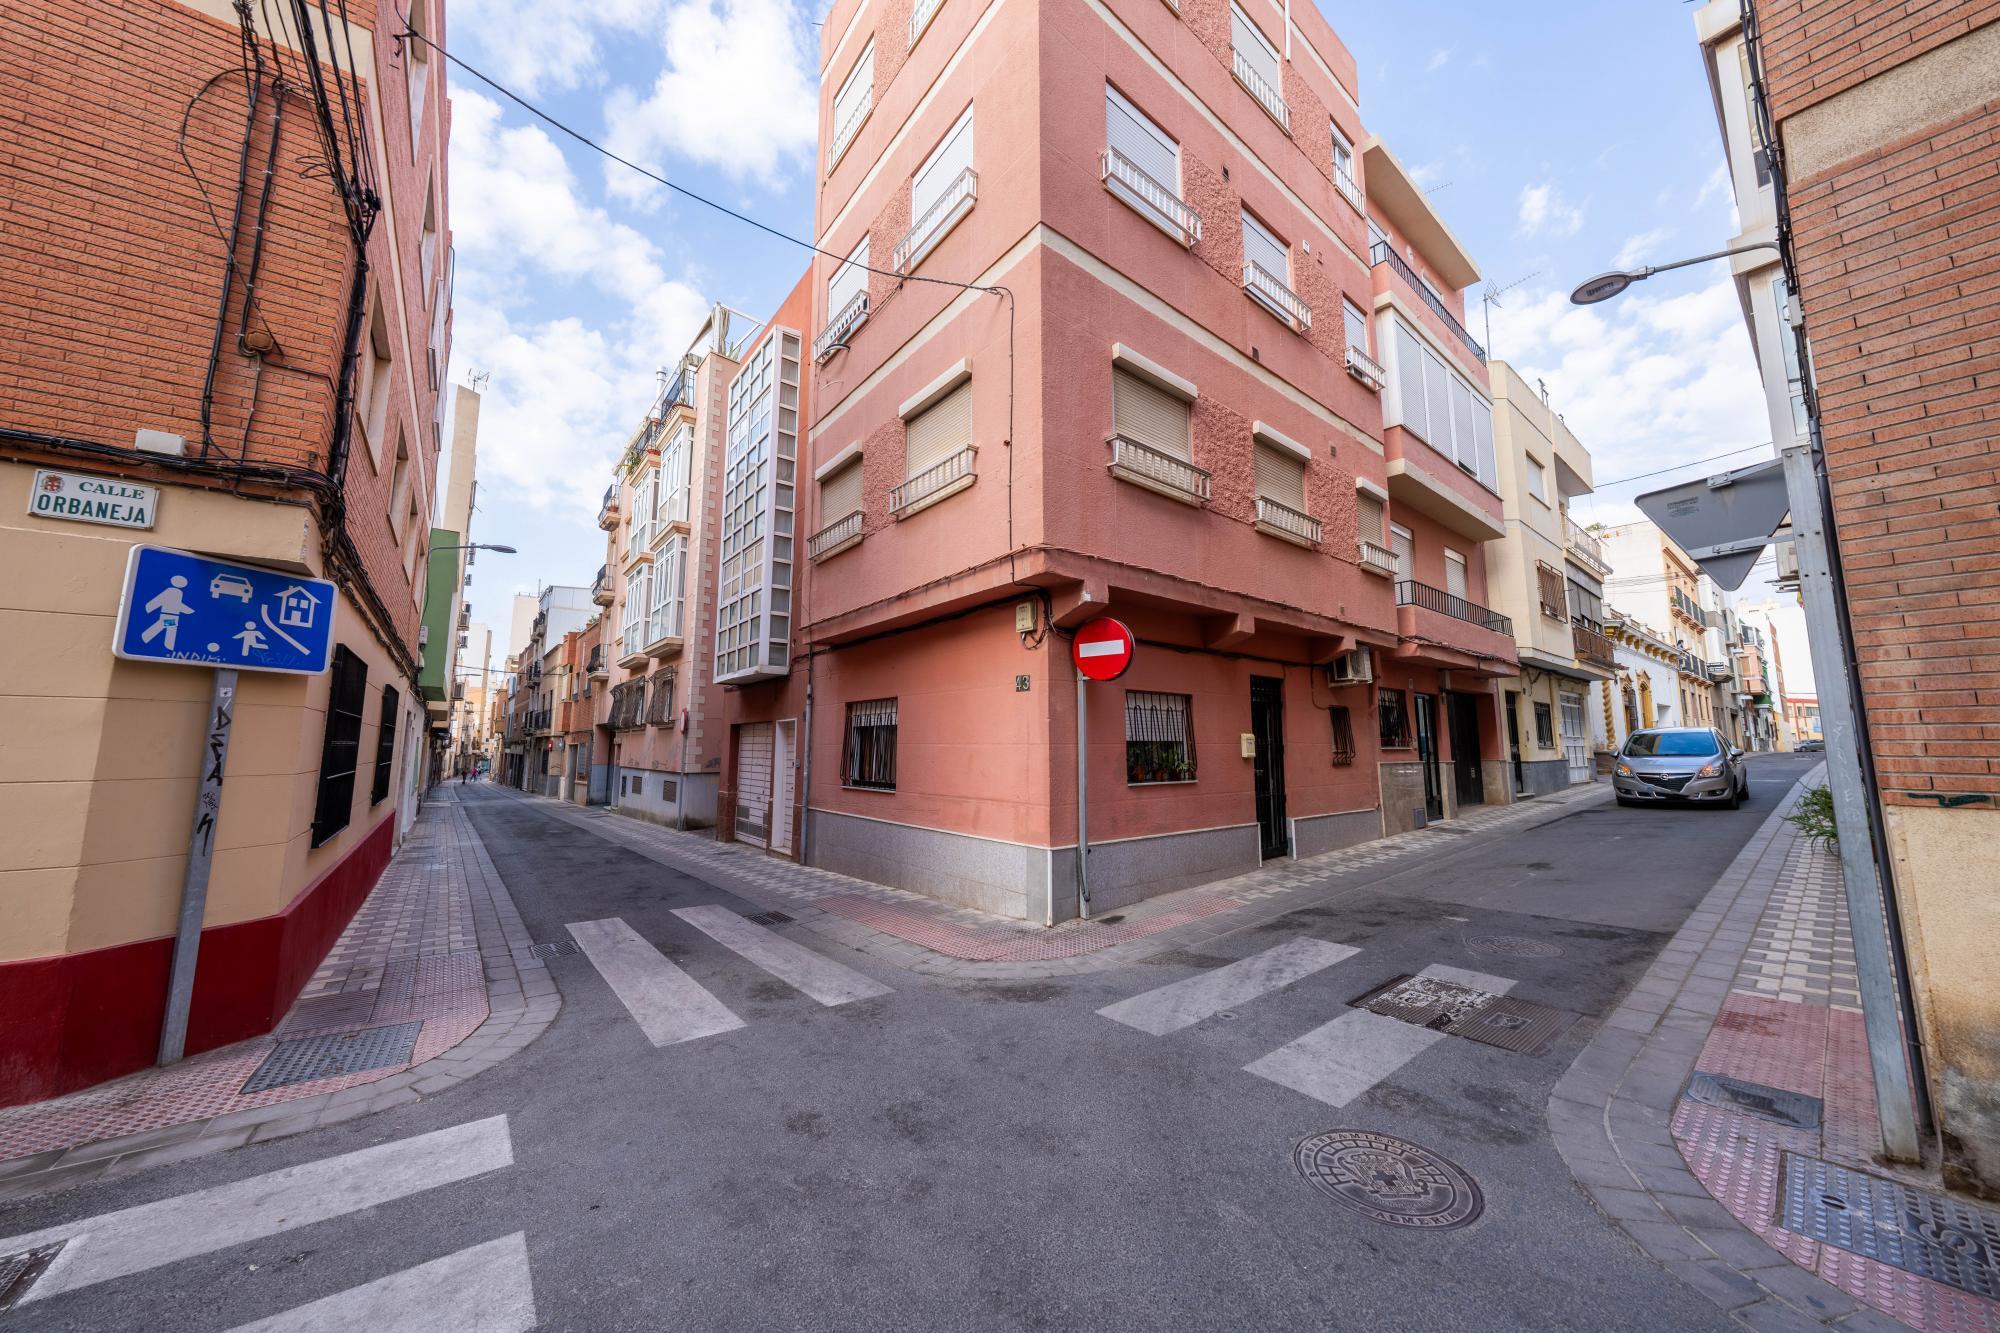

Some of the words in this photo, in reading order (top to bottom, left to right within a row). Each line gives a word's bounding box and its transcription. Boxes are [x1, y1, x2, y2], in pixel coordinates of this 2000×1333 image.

[79, 481, 144, 500] CALLE
[37, 494, 145, 524] ORBANEJA
[1016, 675, 1030, 691] 43
[1304, 1132, 1420, 1154] SANEAMIENTO
[1374, 1211, 1459, 1226] ALMERIA
